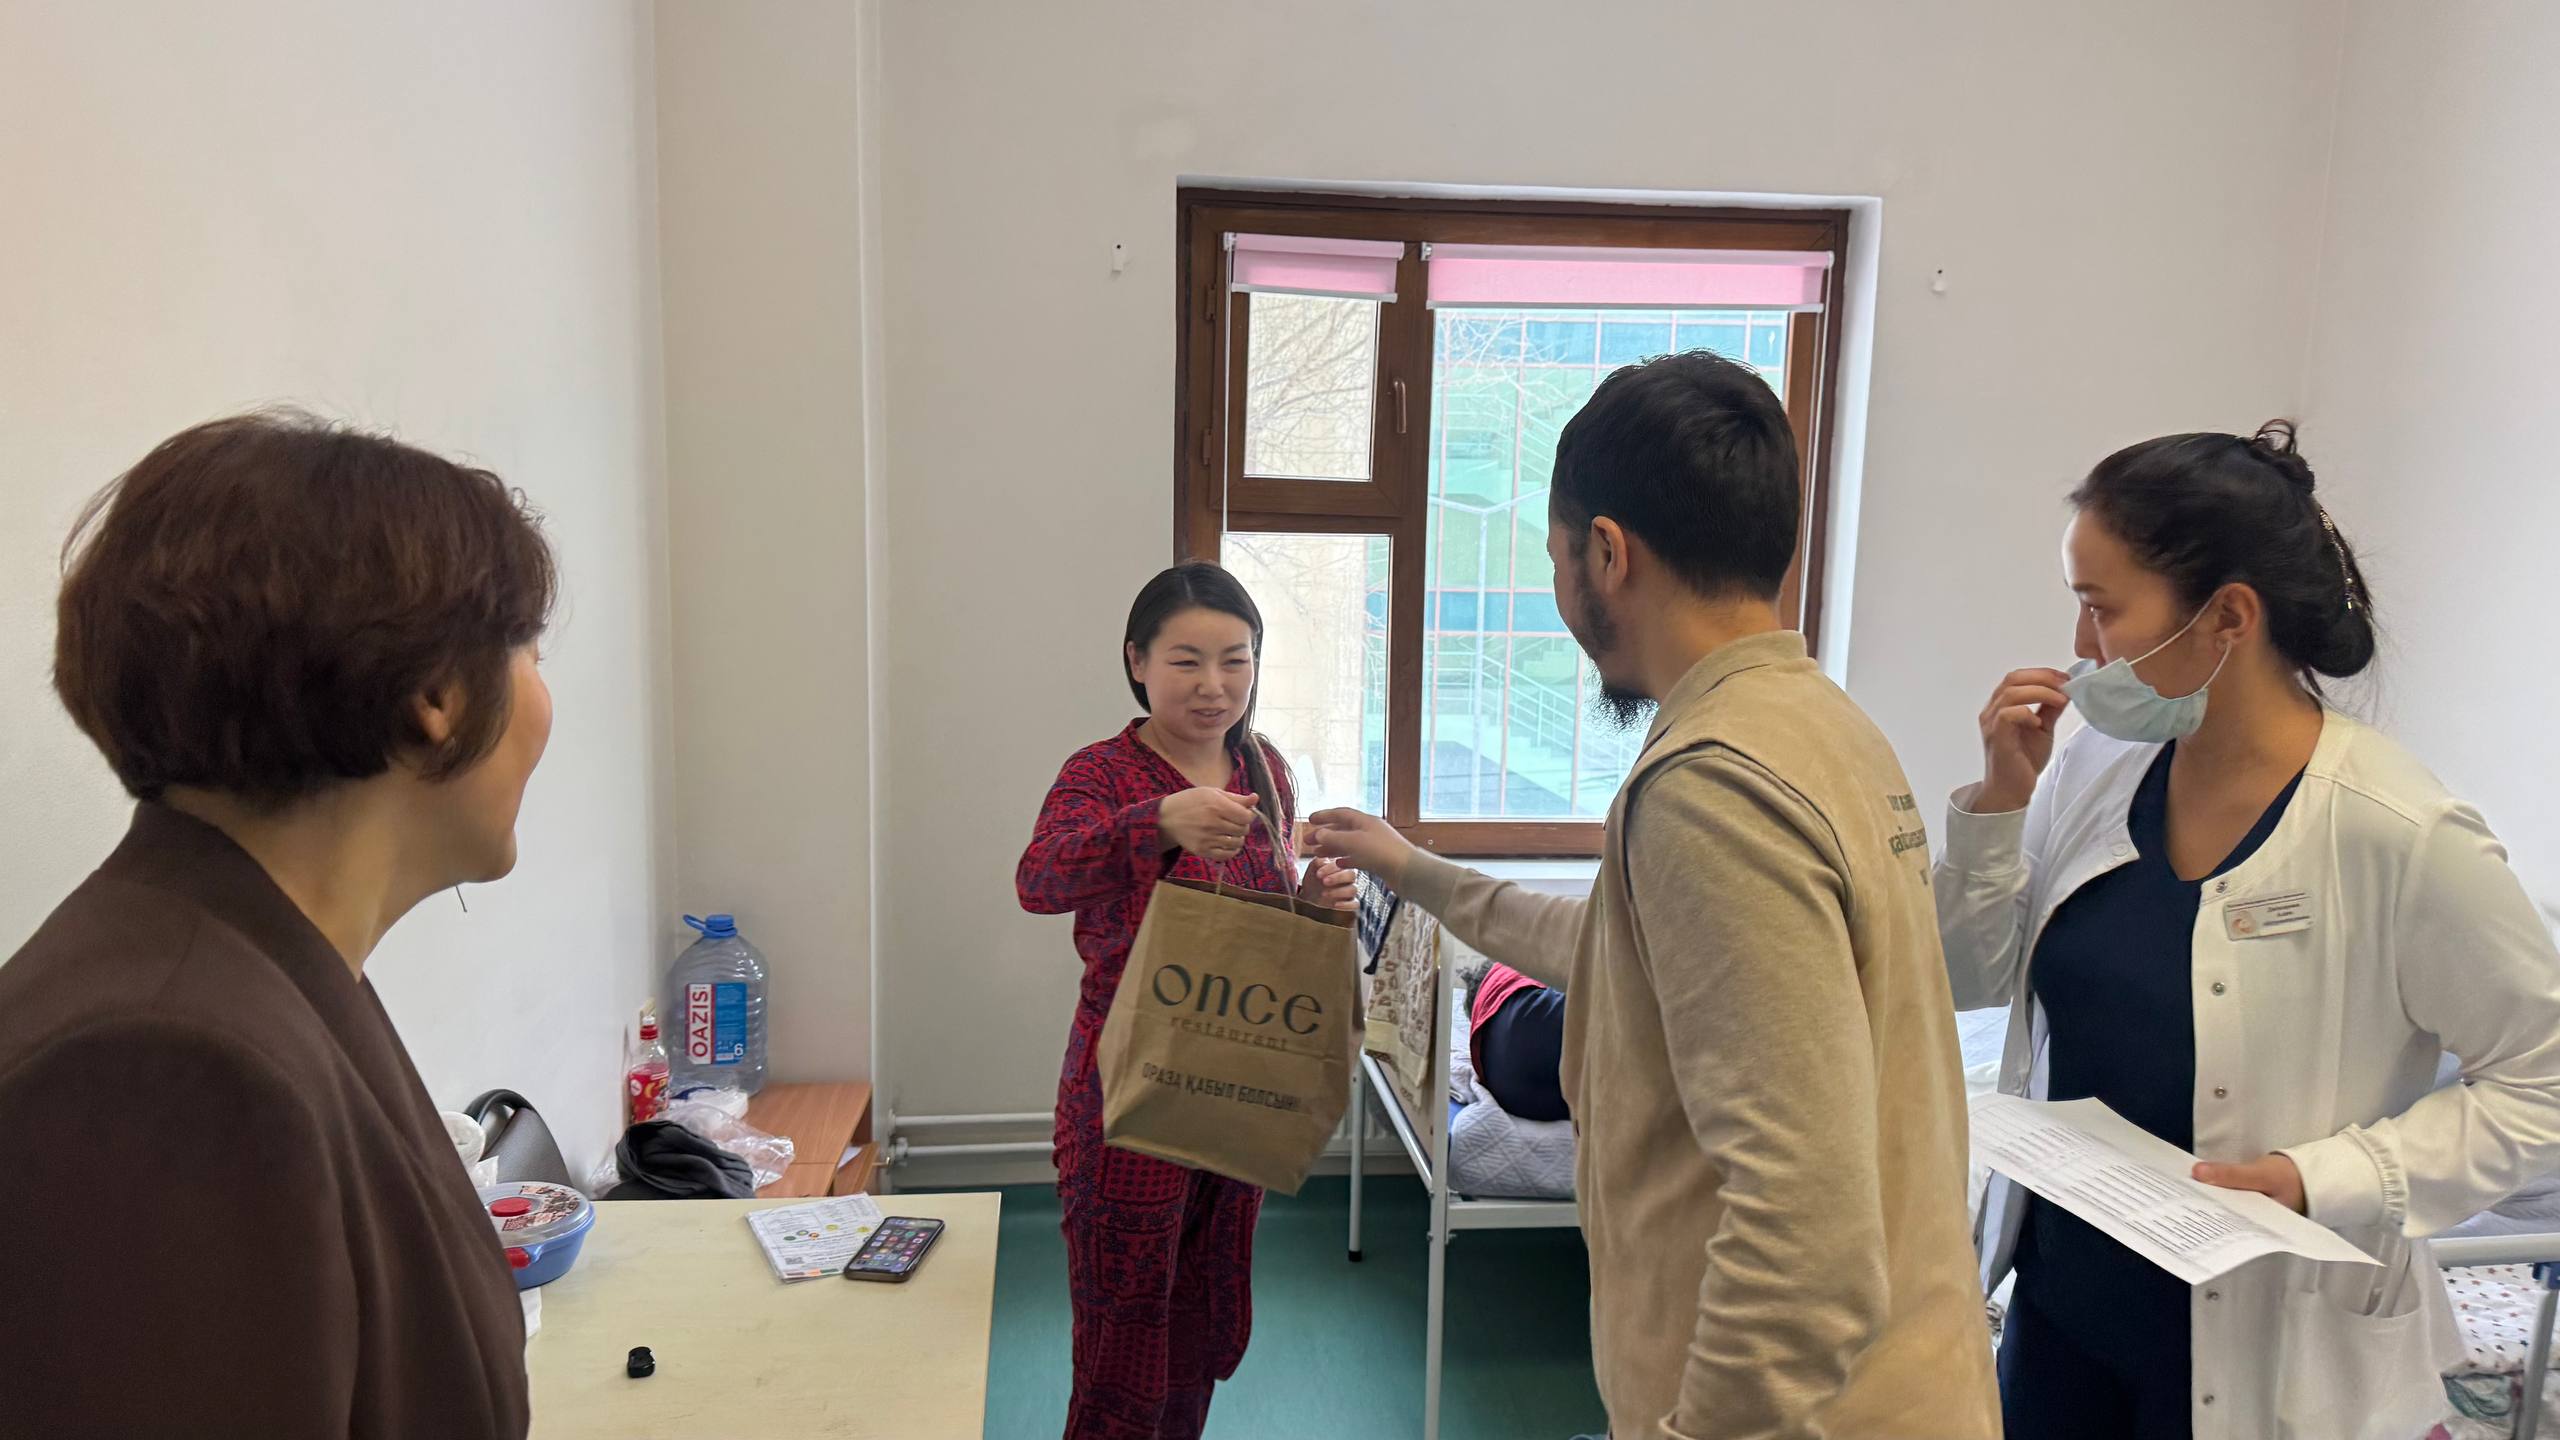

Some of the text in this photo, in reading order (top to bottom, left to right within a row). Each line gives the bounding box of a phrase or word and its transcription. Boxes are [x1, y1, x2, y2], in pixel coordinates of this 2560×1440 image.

[692, 990, 708, 1057] OAZIS
[1153, 964, 1322, 1035] once
[734, 1043, 744, 1056] 6
[1171, 1017, 1288, 1051] restaurant
